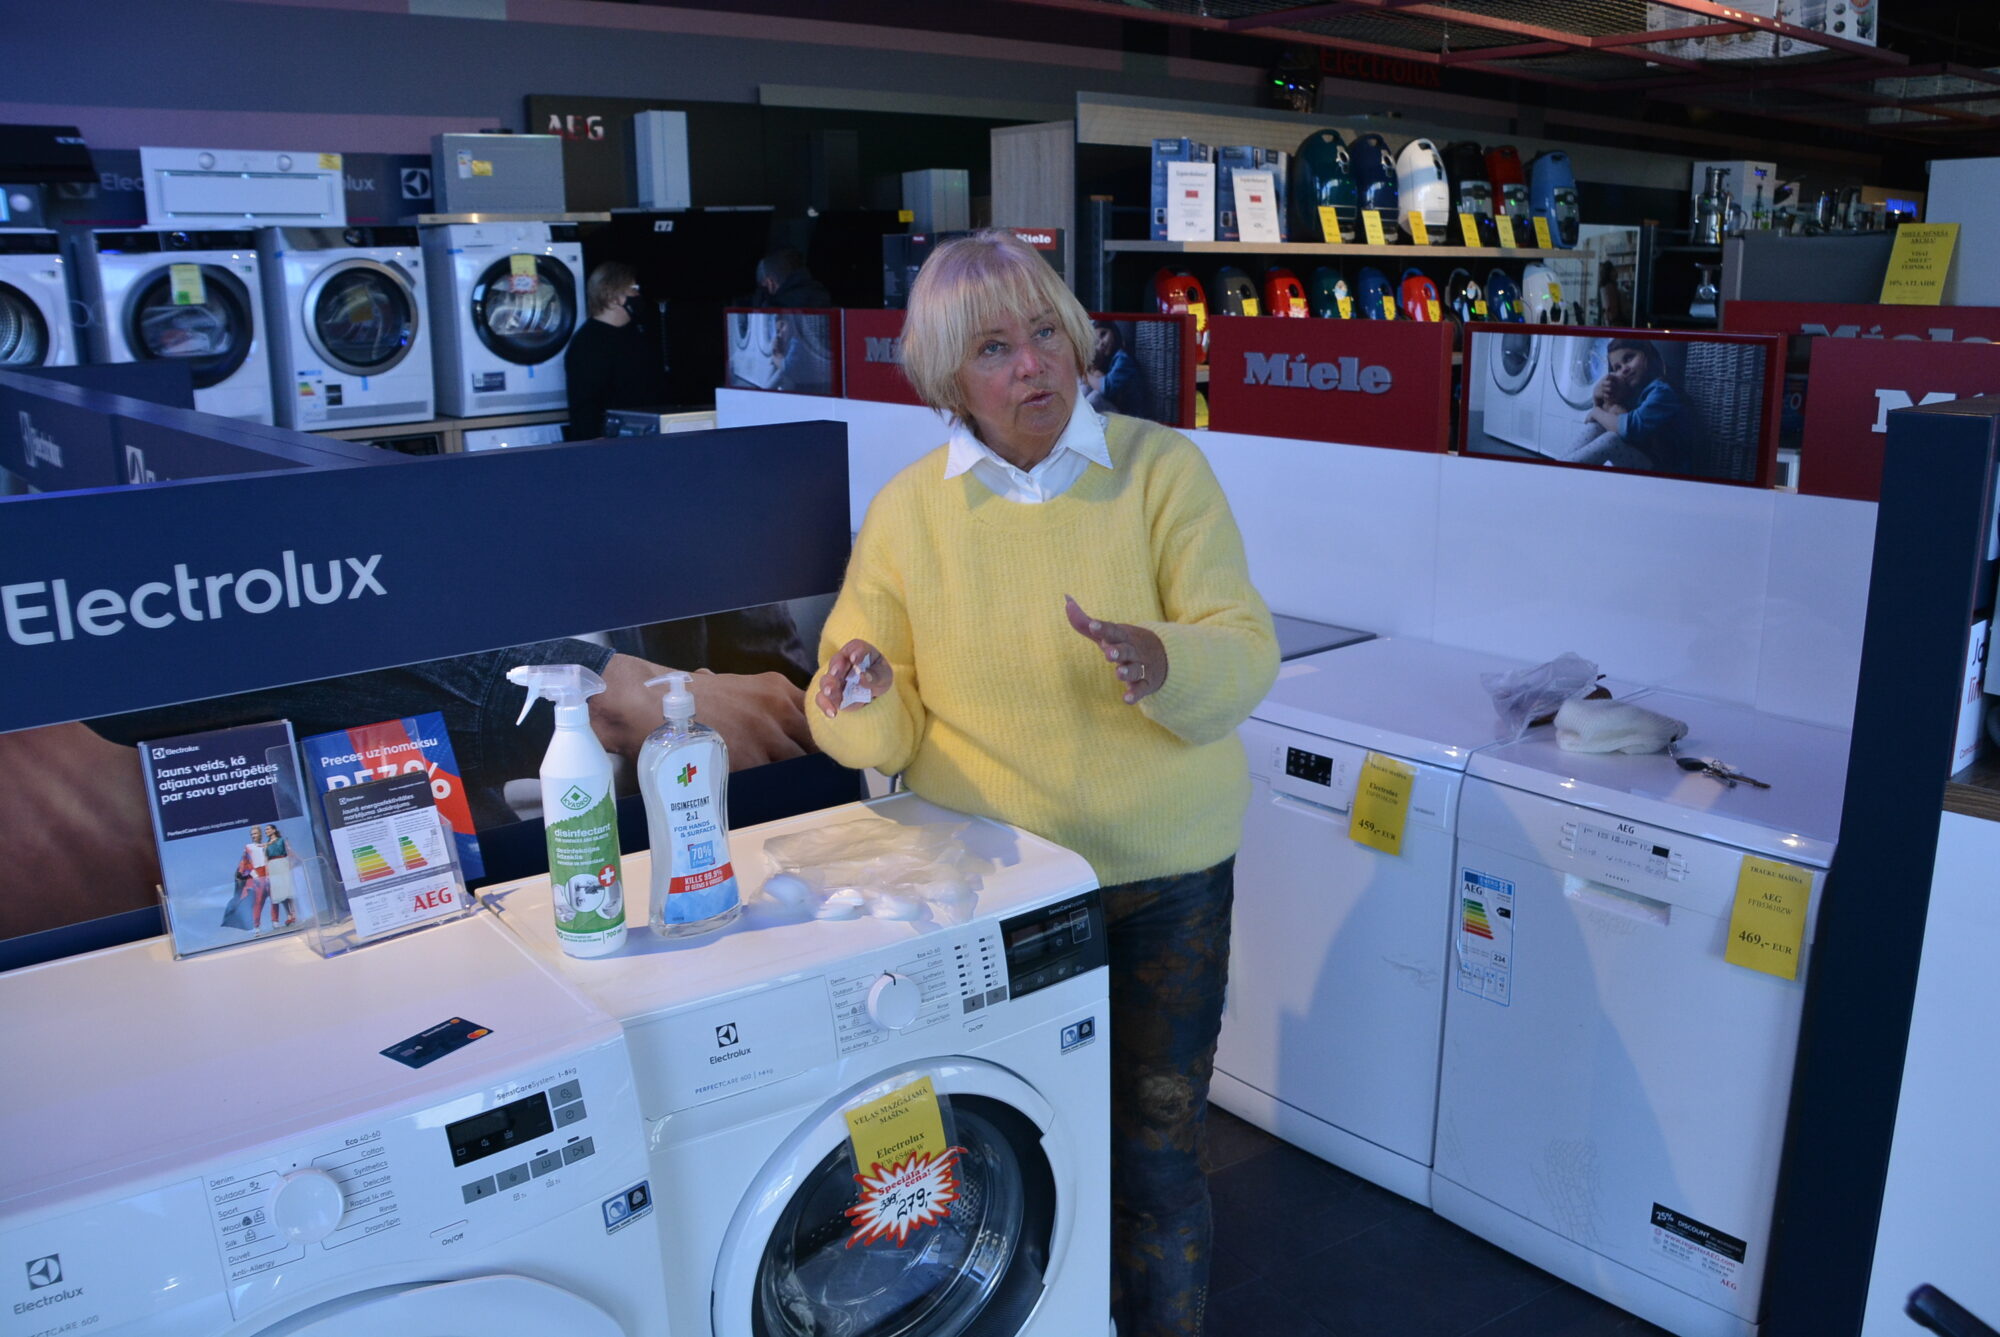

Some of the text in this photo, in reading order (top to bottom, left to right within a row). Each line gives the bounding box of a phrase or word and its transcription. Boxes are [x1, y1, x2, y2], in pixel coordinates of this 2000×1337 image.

[1319, 45, 1441, 89] Electrolux
[548, 114, 604, 141] AEG
[1243, 352, 1392, 394] Miele
[1, 550, 388, 646] Electrolux
[165, 745, 200, 756] Electrolux
[321, 737, 438, 768] Preces uz nomaksu
[156, 755, 247, 779] Jauns veids, kā
[159, 763, 279, 792] atjaunot un rūpēties
[161, 774, 278, 805] par savu garderobi
[563, 796, 589, 808] KVADRO
[671, 796, 710, 811] DISINFECTANT
[554, 823, 611, 838] disinfectant
[674, 820, 710, 833] FOR HANDS
[687, 825, 716, 837] SURFACES
[1617, 823, 1635, 835] AEG
[691, 844, 713, 859] 70%
[684, 875, 702, 885] KILLS
[1464, 883, 1483, 896] AEG
[1761, 892, 1782, 903] AEG
[413, 887, 453, 912] AEG
[1739, 930, 1792, 954] 469,- EUR
[709, 1047, 752, 1065] Electrolux
[496, 1074, 556, 1101] SensiCareSystem
[695, 1077, 738, 1094] PERFECTCARE
[345, 1131, 381, 1147] Eco 40-60
[877, 1131, 925, 1159] Electrolux
[361, 1146, 385, 1157] Cotton
[354, 1160, 388, 1176] Synthetics
[210, 1174, 234, 1187] Denim
[363, 1174, 391, 1188] Delicate
[878, 1169, 920, 1196] Speciāla
[905, 1168, 931, 1188] cena!
[214, 1189, 246, 1203] Outdoor
[350, 1190, 393, 1208] Rapid 14 min
[897, 1188, 932, 1219] 279,-
[218, 1207, 238, 1218] Sport
[379, 1203, 397, 1214] Rinse
[222, 1222, 242, 1233] Wool
[364, 1217, 400, 1233] Drain/Spin
[1655, 1211, 1710, 1239] 25% DISCOUNT
[224, 1239, 237, 1249] Silk
[441, 1232, 465, 1246] On/Off
[228, 1251, 250, 1263] Duvet
[232, 1259, 275, 1278] Anti-Allergy
[1721, 1278, 1737, 1290] AEG
[13, 1287, 84, 1315] Electrolux
[81, 1314, 99, 1327] 600
